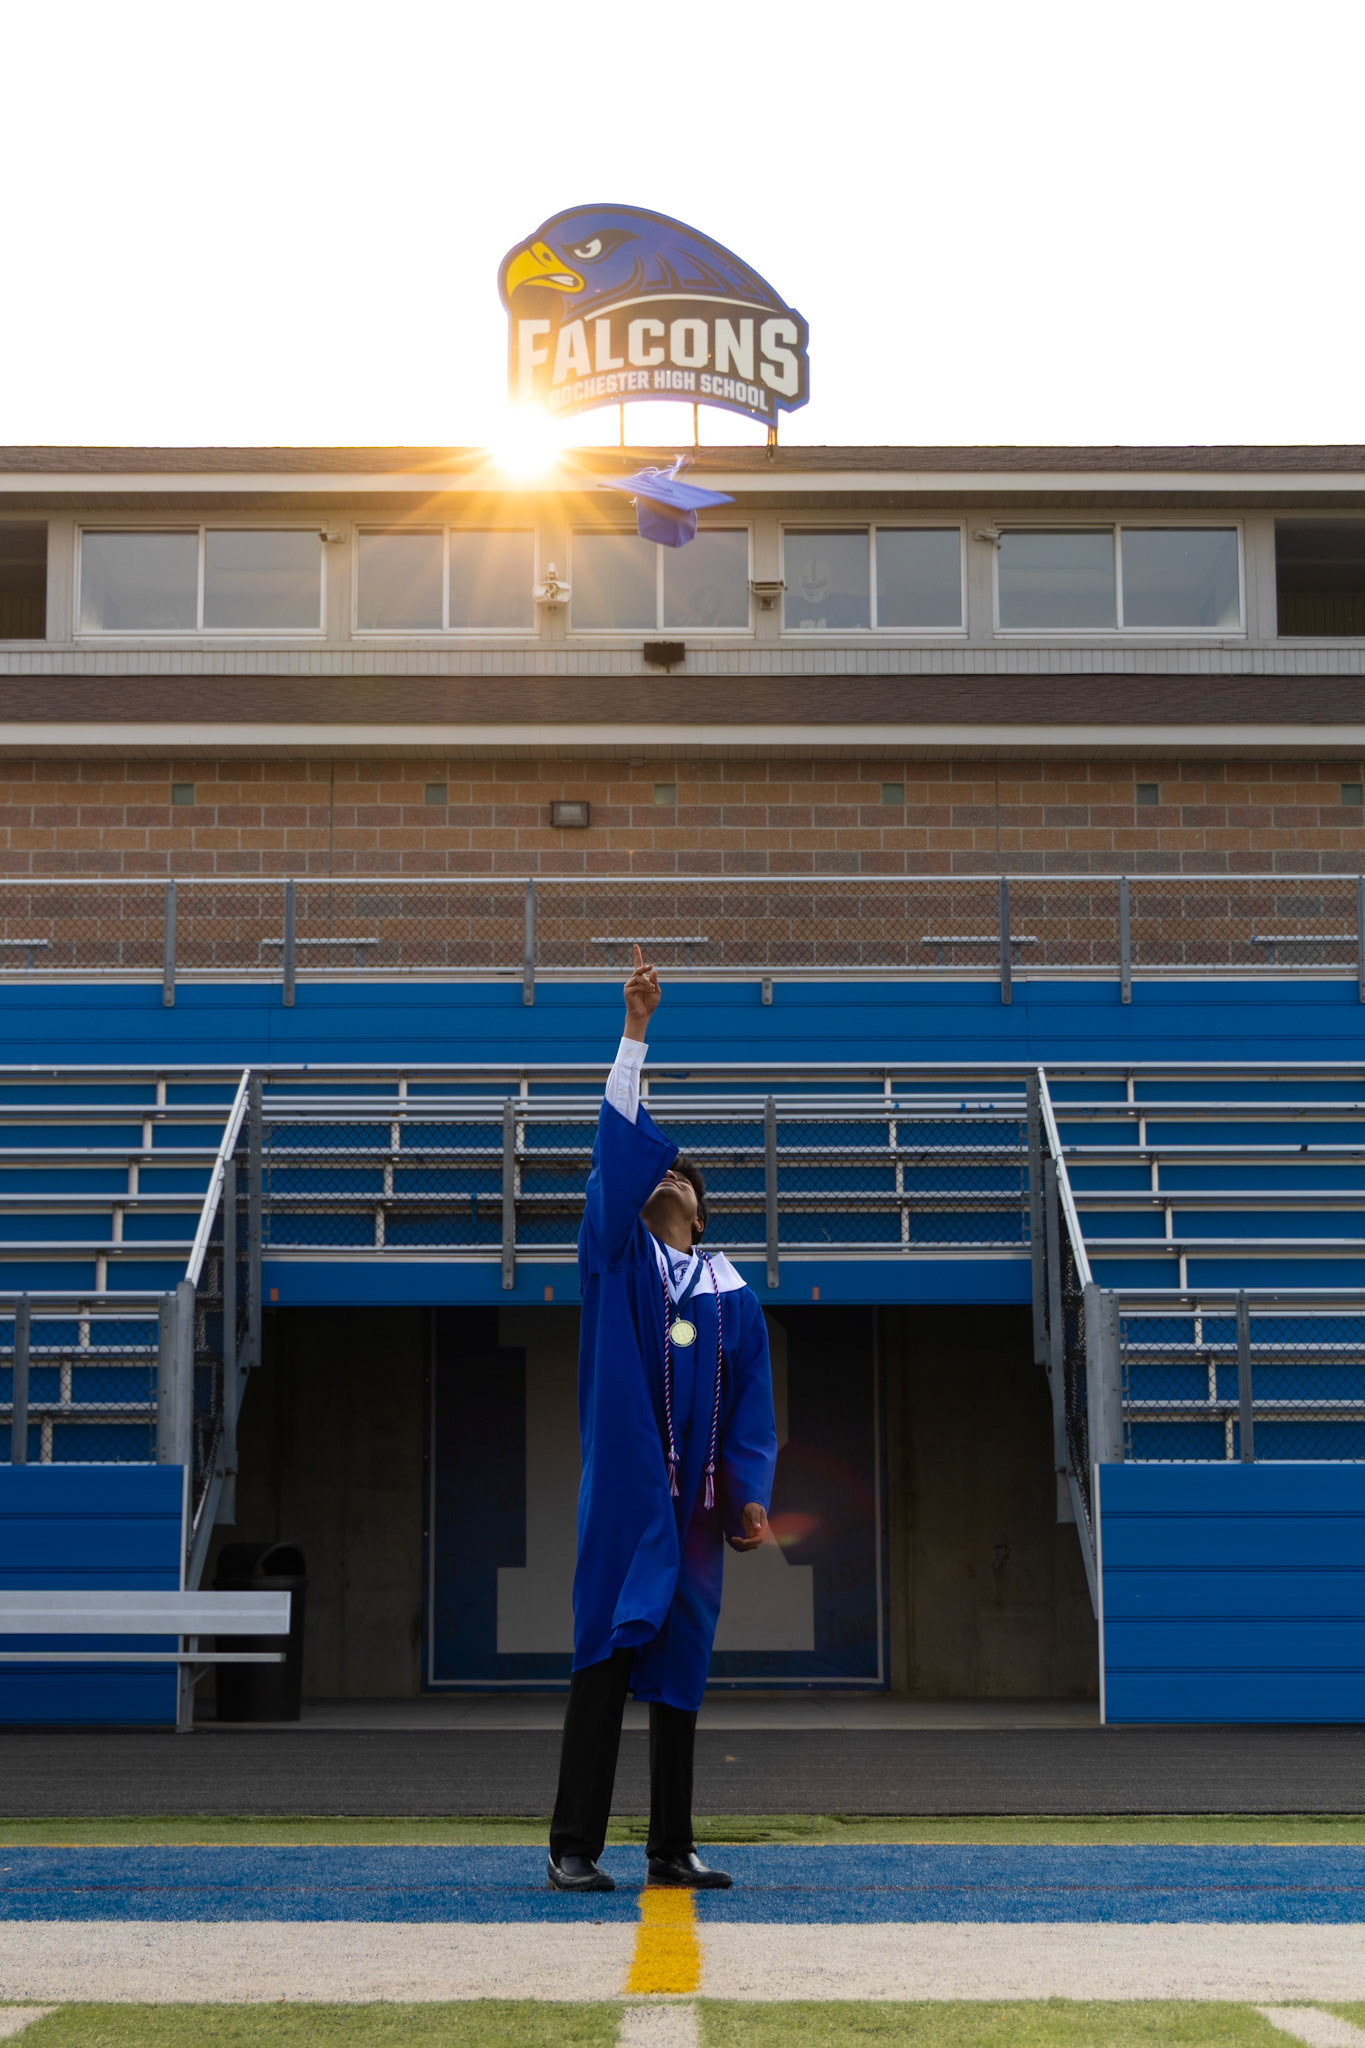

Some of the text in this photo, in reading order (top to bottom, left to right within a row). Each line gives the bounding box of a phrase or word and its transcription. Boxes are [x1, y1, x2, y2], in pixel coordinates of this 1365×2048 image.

[518, 318, 799, 398] FALCONS
[653, 369, 696, 391] HIGH
[699, 375, 769, 412] SCHOOL
